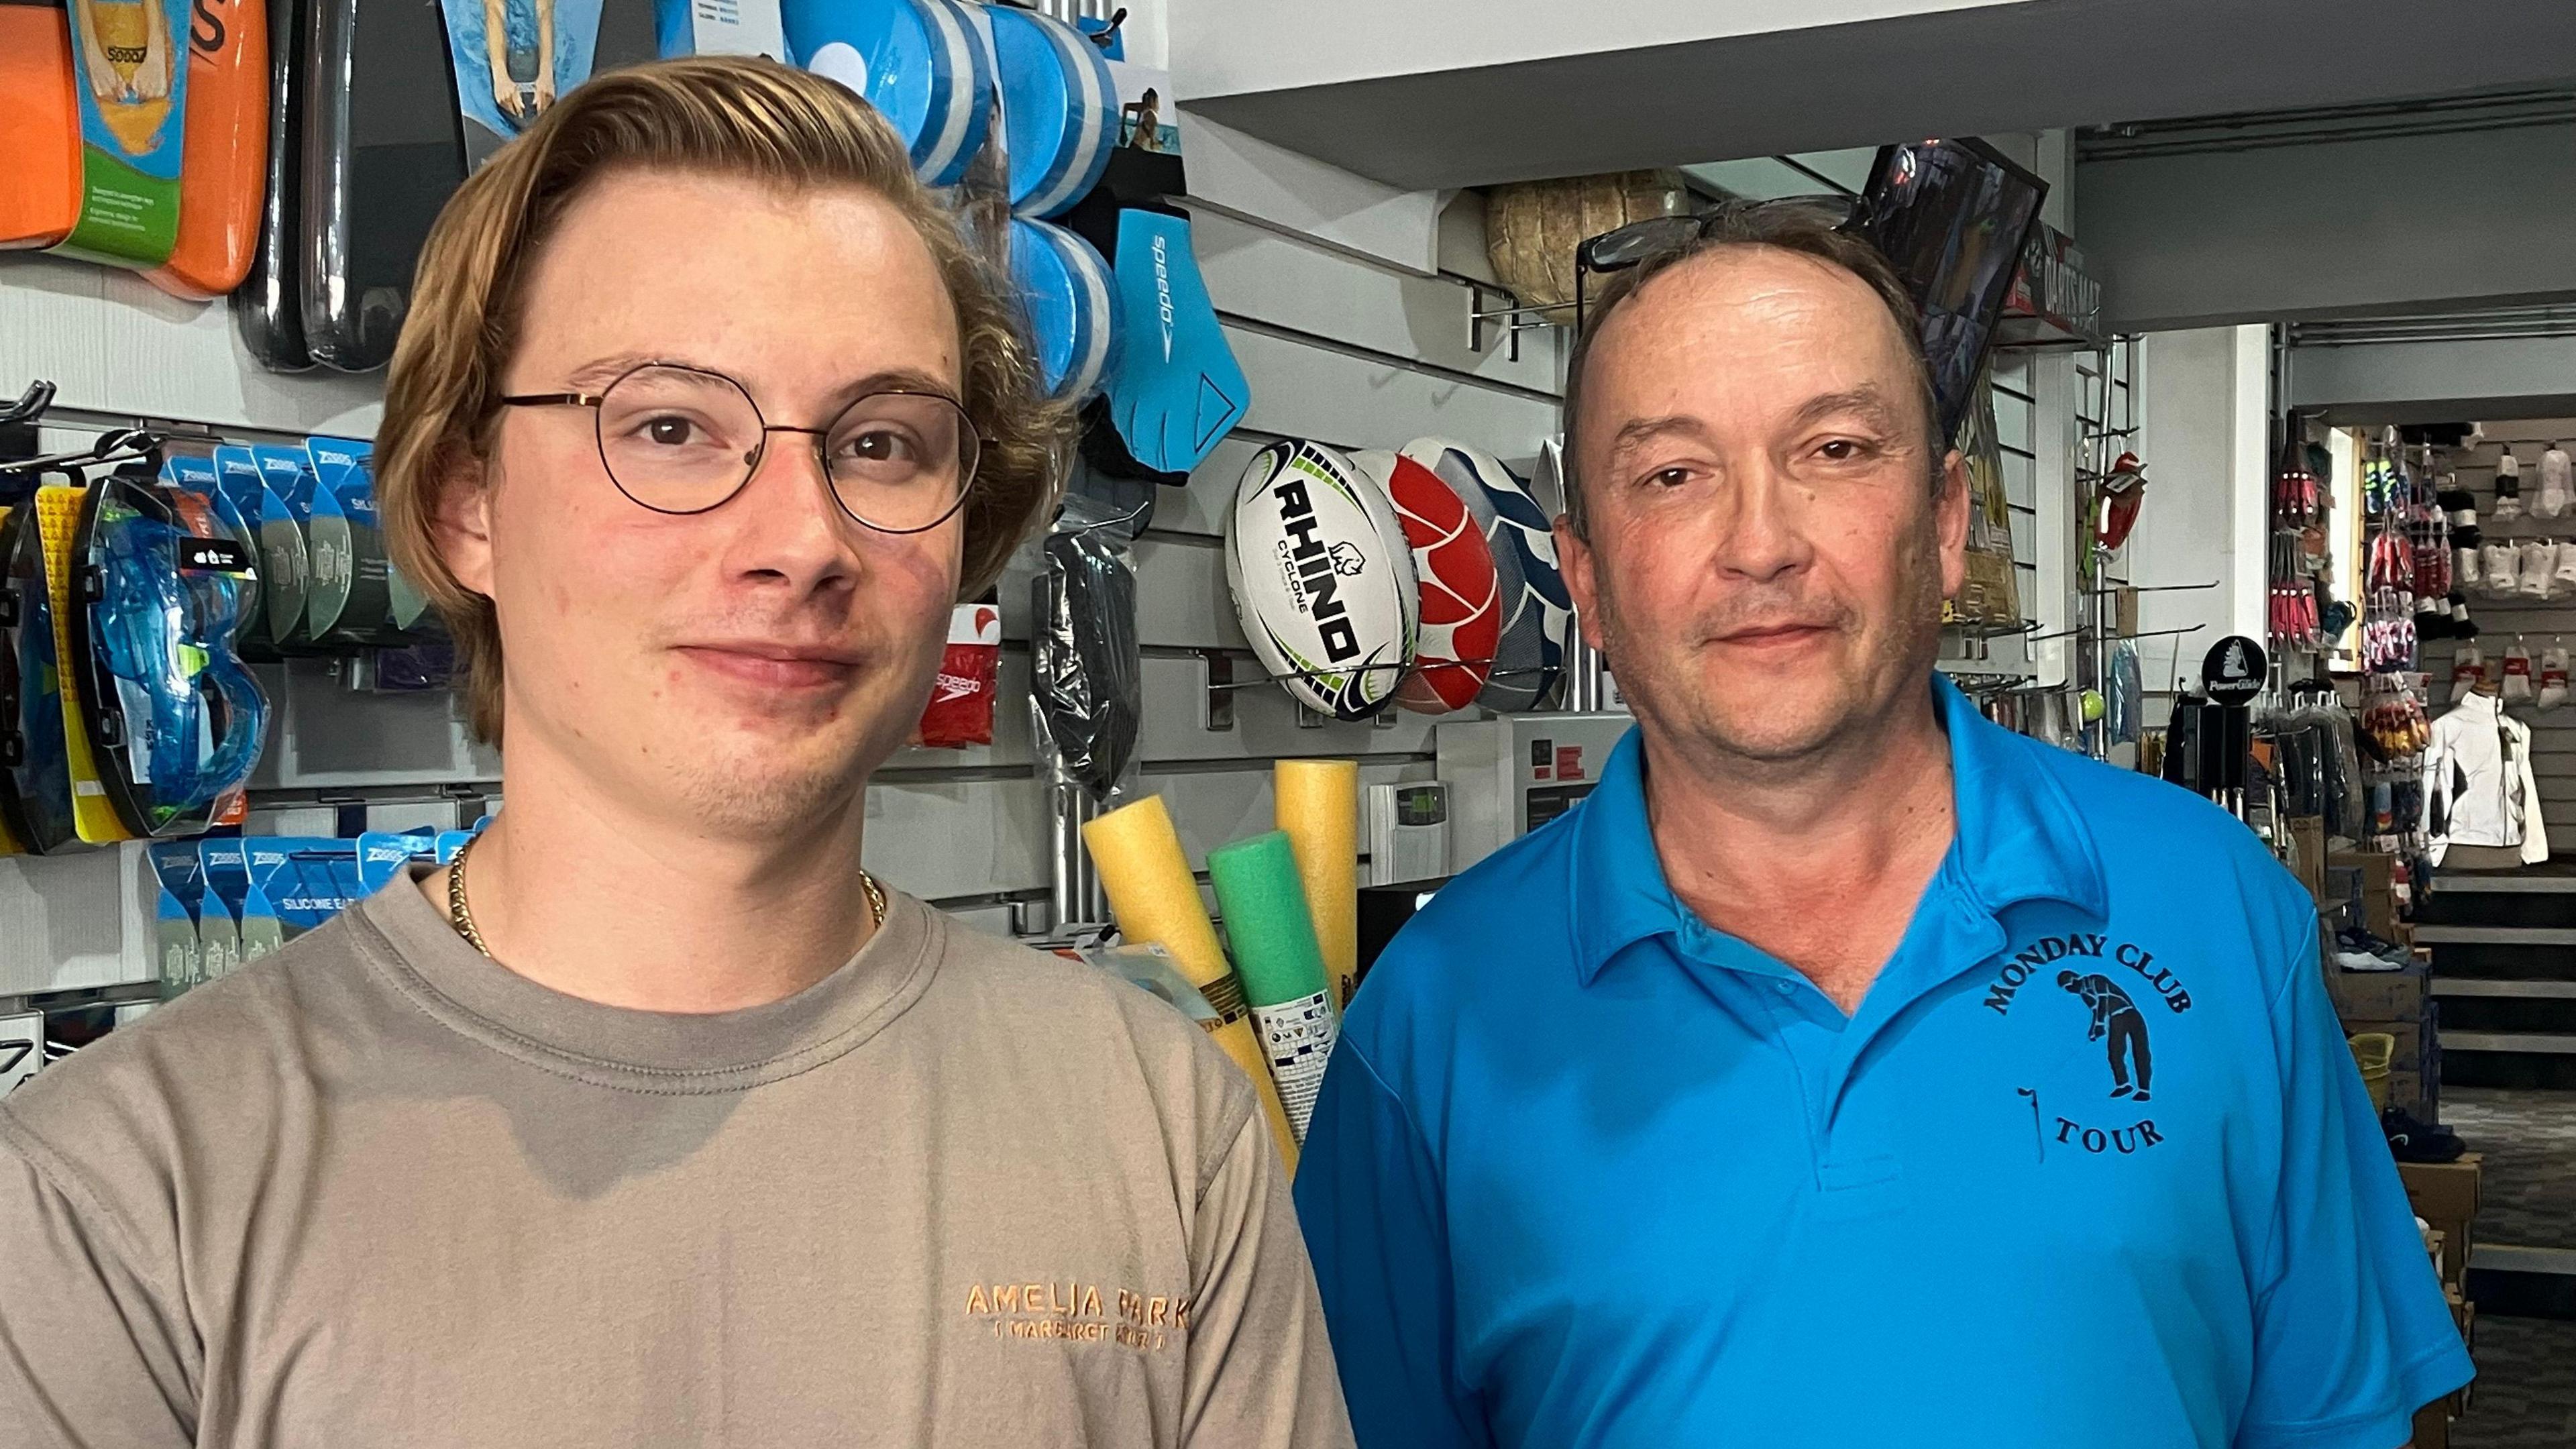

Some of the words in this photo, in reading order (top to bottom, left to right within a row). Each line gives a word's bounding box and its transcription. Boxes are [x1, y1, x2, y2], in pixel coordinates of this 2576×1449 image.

[1152, 234, 1175, 323] speedo
[1273, 479, 1361, 664] RHINO
[1277, 539, 1309, 614] CYCLONE
[936, 673, 981, 694] speedo
[282, 898, 334, 911] SILICONE
[1983, 933, 2108, 1016] MONDAY
[2116, 943, 2192, 1014] CLUB
[2055, 1116, 2165, 1155] TOUR
[966, 1282, 1103, 1317] AMELIA
